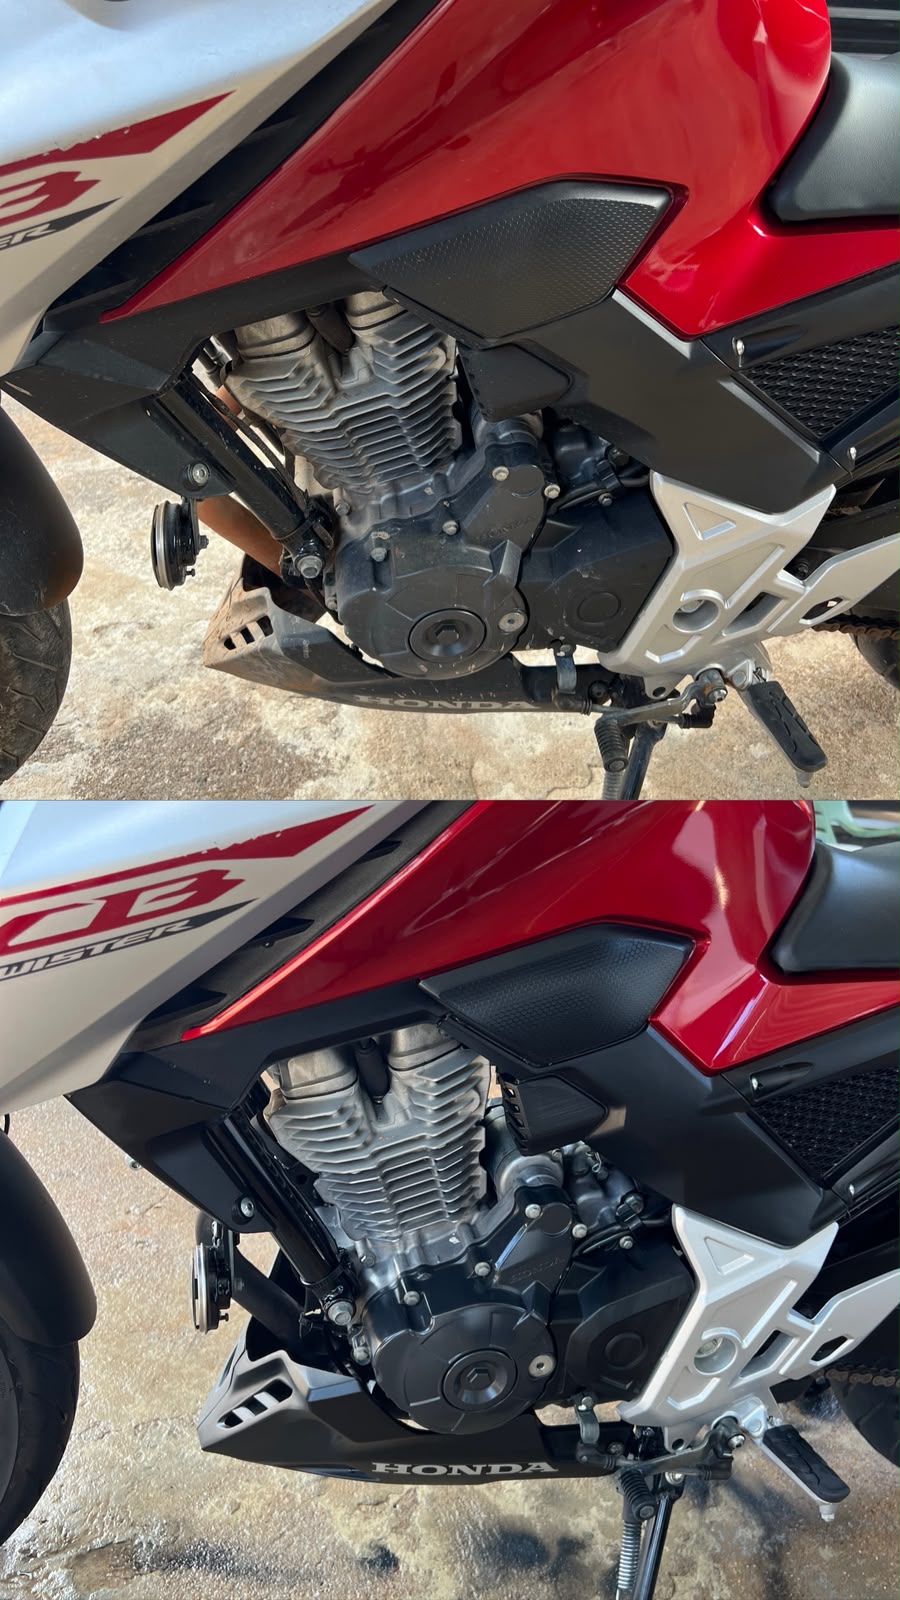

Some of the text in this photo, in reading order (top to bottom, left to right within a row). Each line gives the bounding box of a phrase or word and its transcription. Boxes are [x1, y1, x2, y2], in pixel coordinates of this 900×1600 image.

[353, 695, 541, 709] HONDA
[0, 869, 246, 957] CB
[372, 1461, 559, 1476] HONDA
